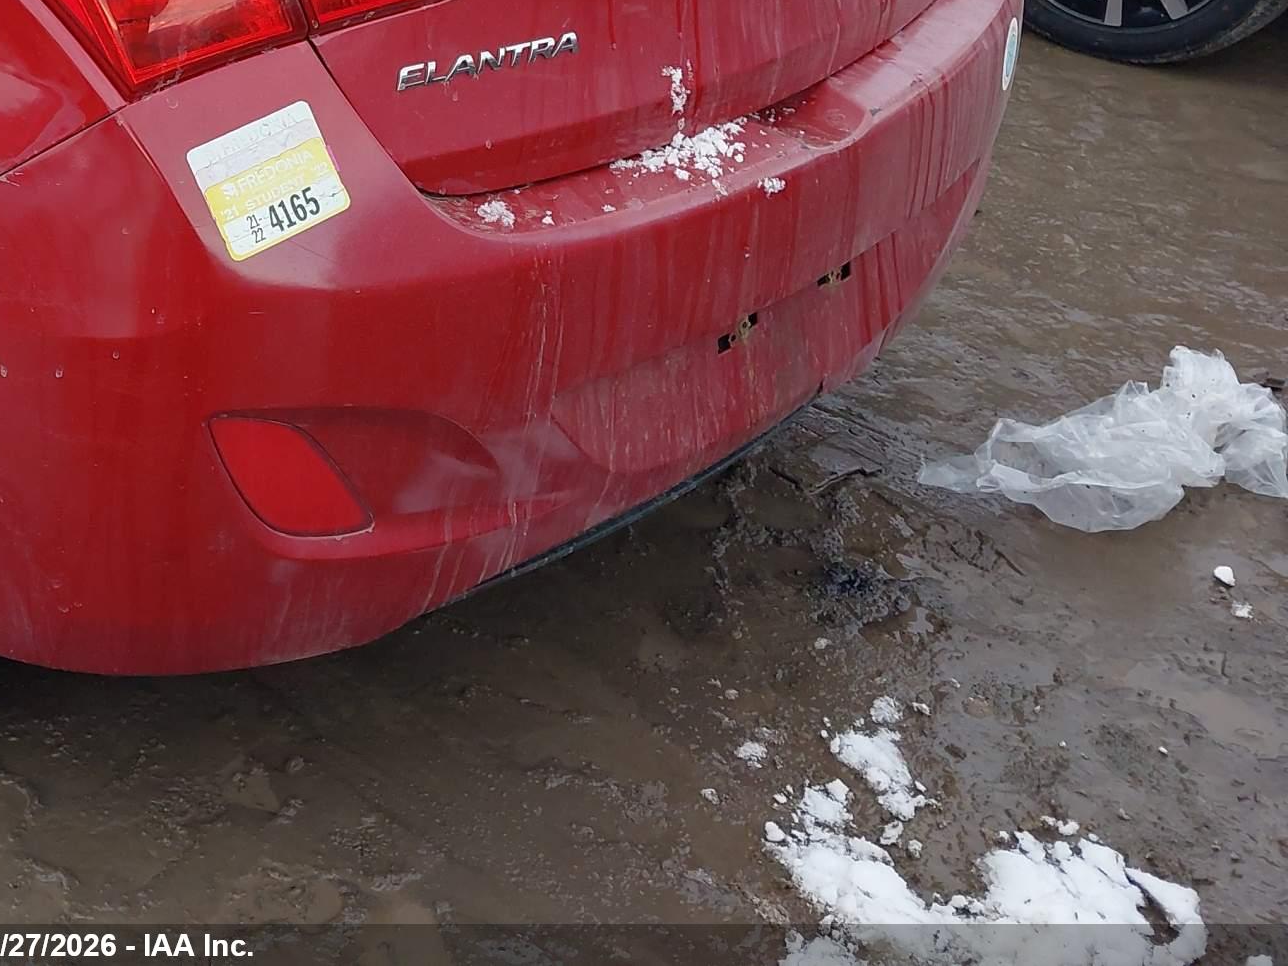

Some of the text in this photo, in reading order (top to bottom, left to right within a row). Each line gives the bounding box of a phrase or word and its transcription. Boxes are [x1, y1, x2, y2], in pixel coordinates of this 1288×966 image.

[397, 31, 579, 91] ELANTRA
[239, 150, 314, 192] FREDONIA
[245, 176, 306, 210] STUDENT
[268, 186, 321, 232] 4165
[251, 228, 266, 244] 22
